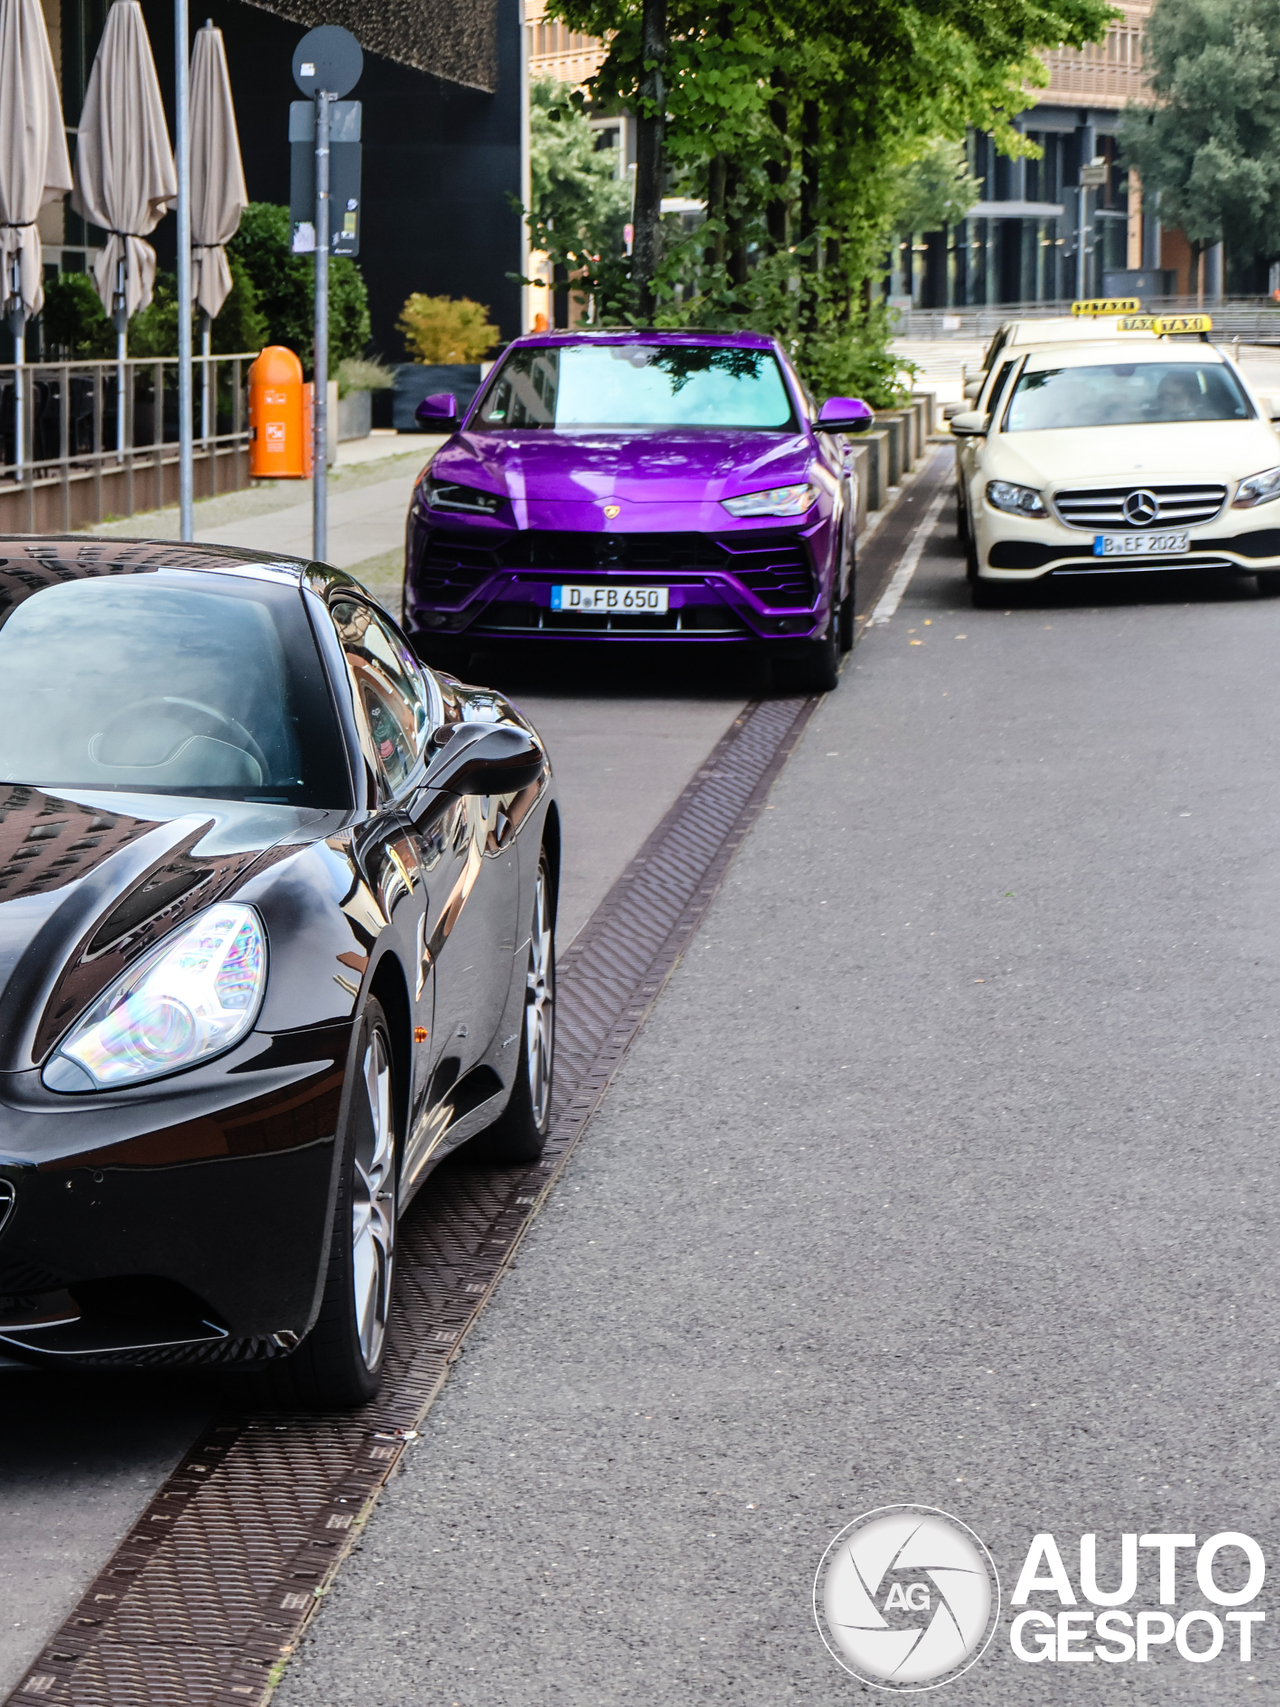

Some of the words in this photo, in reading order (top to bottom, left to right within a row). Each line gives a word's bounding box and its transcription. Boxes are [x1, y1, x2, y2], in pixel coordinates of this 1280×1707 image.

[1124, 319, 1154, 330] TAX
[1162, 318, 1202, 330] TAXI
[569, 588, 581, 606] D
[593, 589, 618, 607] FB
[623, 590, 658, 608] 650
